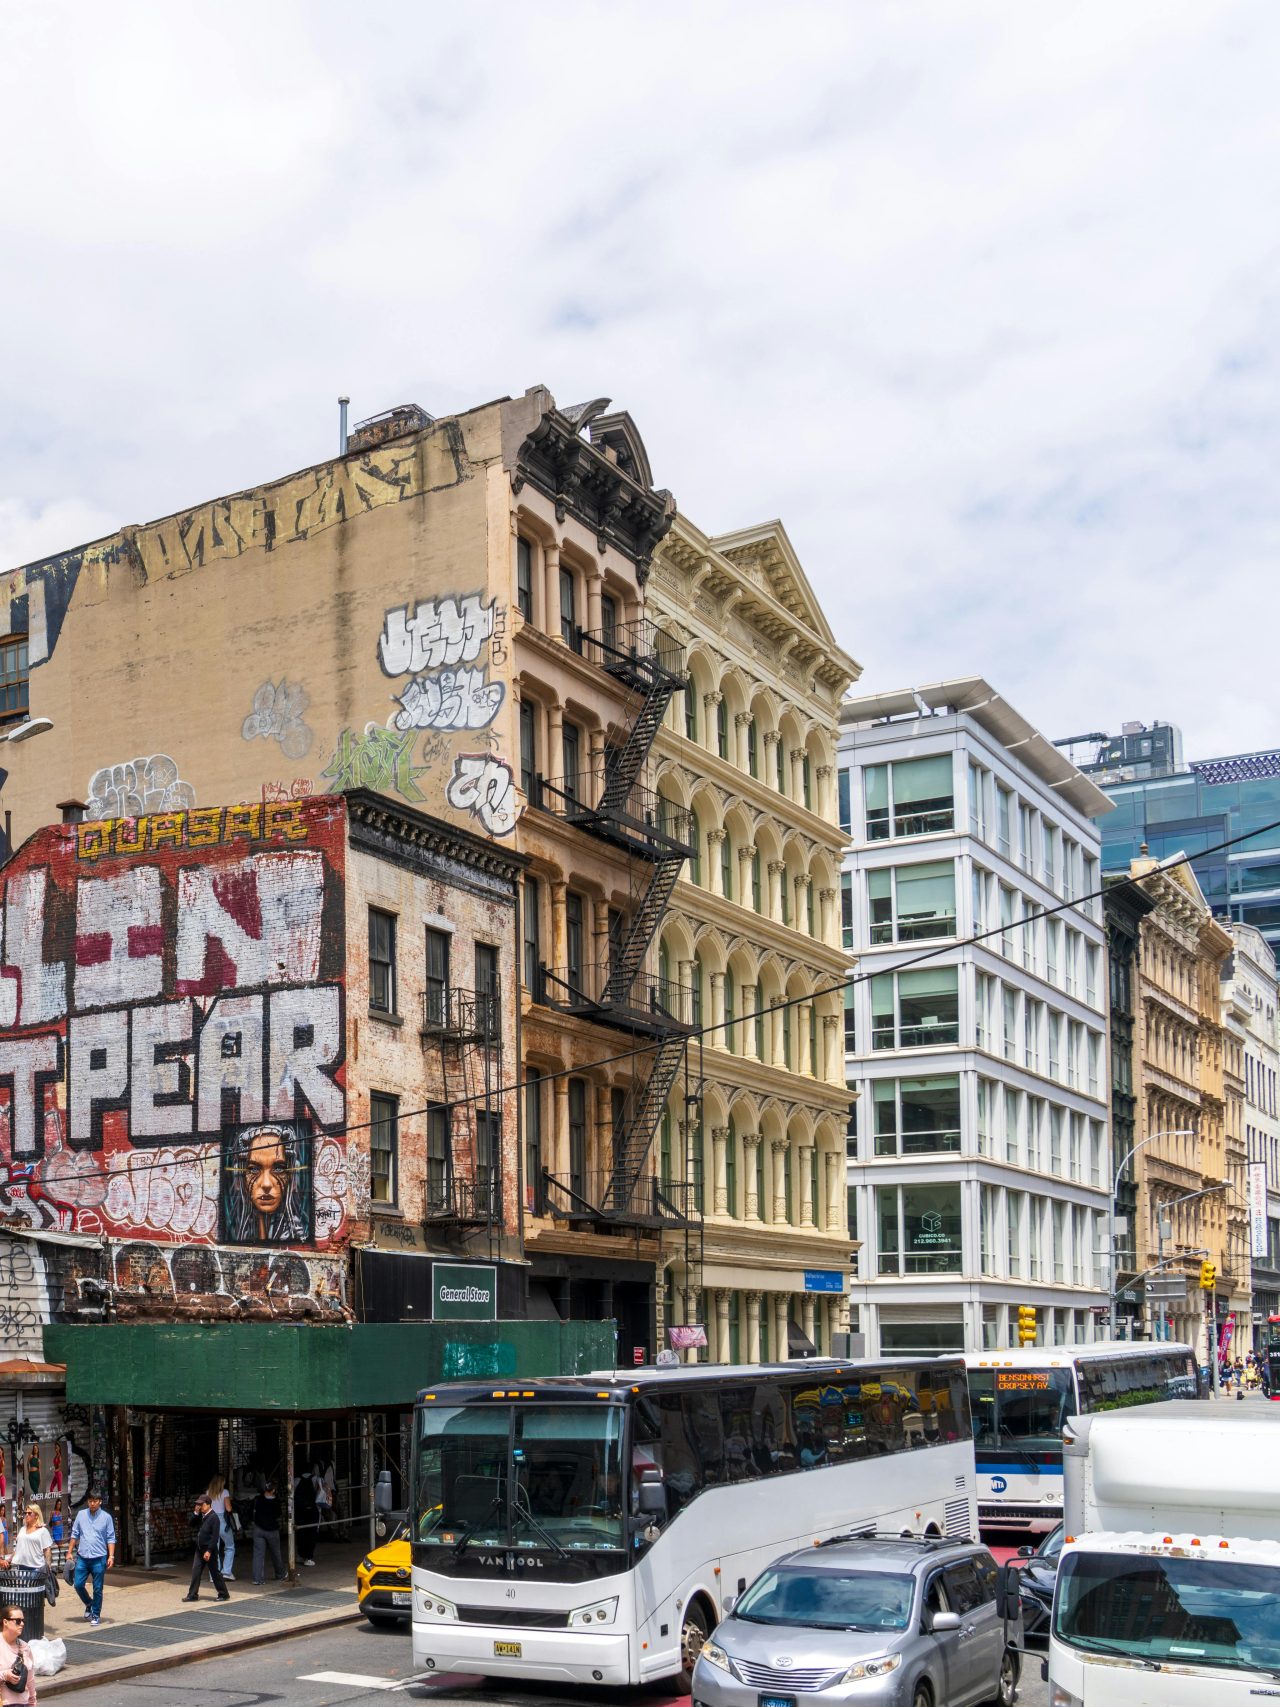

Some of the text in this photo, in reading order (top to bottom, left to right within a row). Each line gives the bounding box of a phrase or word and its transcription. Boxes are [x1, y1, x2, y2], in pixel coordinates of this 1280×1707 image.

[76, 799, 309, 864] QUASAR
[439, 1285, 490, 1303] General Store
[998, 1382, 1035, 1390] CROPSEY
[44, 1491, 62, 1500] ACTIVE
[478, 1556, 504, 1566] VAN
[505, 1588, 516, 1600] 40
